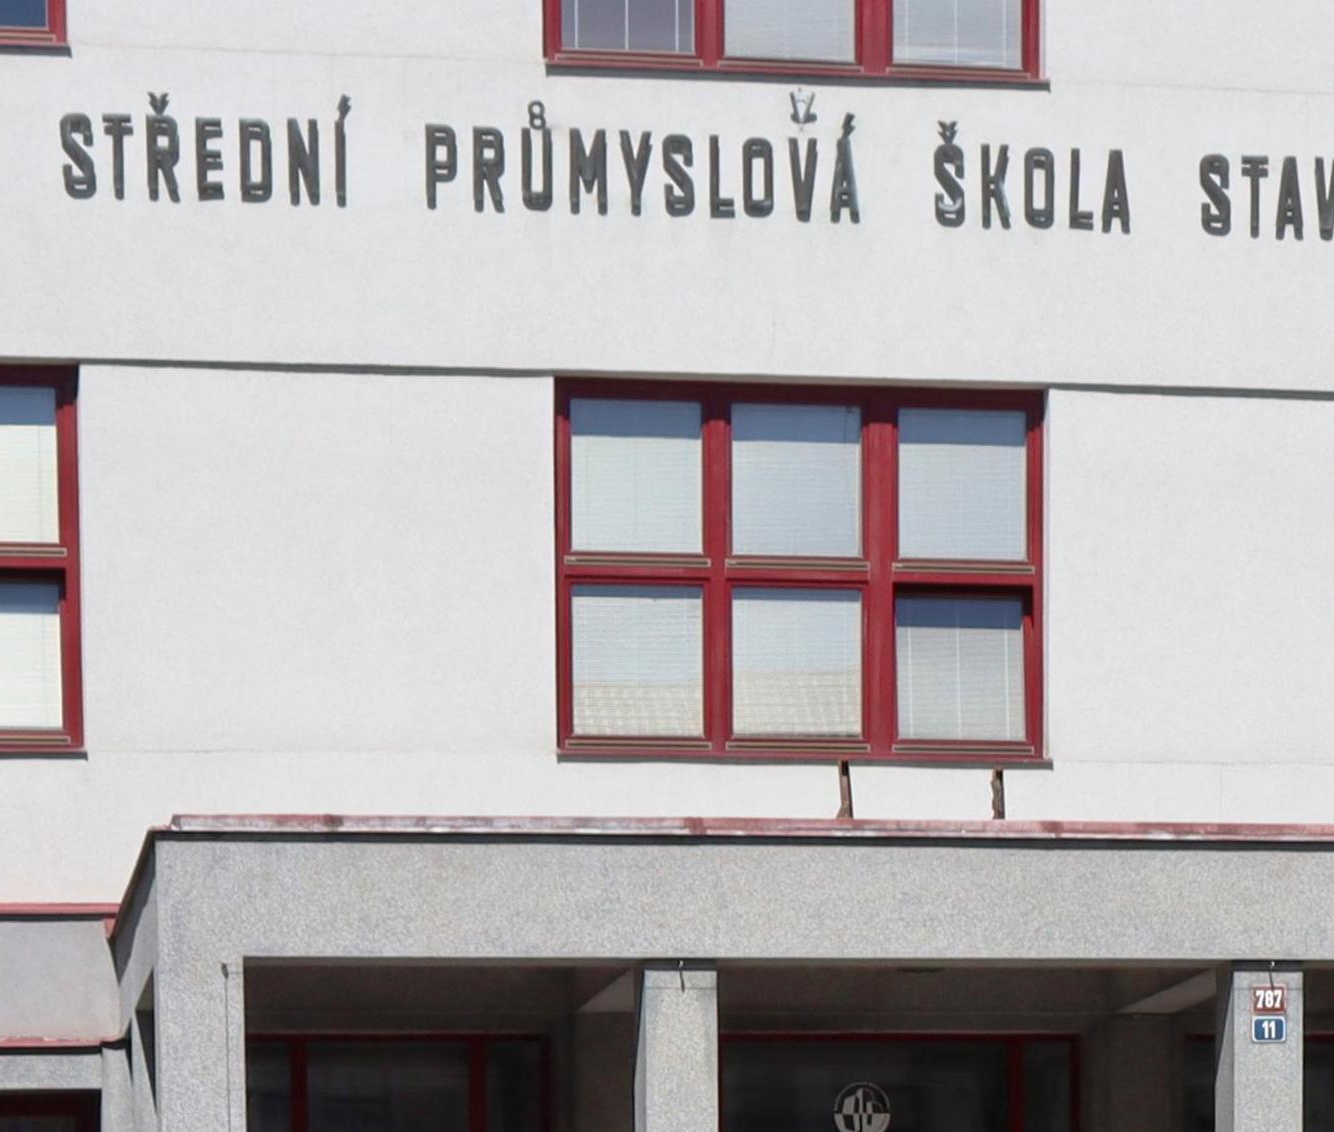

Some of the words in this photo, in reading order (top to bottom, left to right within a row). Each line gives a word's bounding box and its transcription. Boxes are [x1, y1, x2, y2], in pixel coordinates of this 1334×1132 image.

[59, 91, 352, 208] STŘEDNÍ
[423, 100, 861, 224] PRŮMYSLOVÁ
[933, 120, 1131, 235] ŠKOLA
[1255, 990, 1282, 1008] 787
[1262, 1020, 1276, 1039] 11
